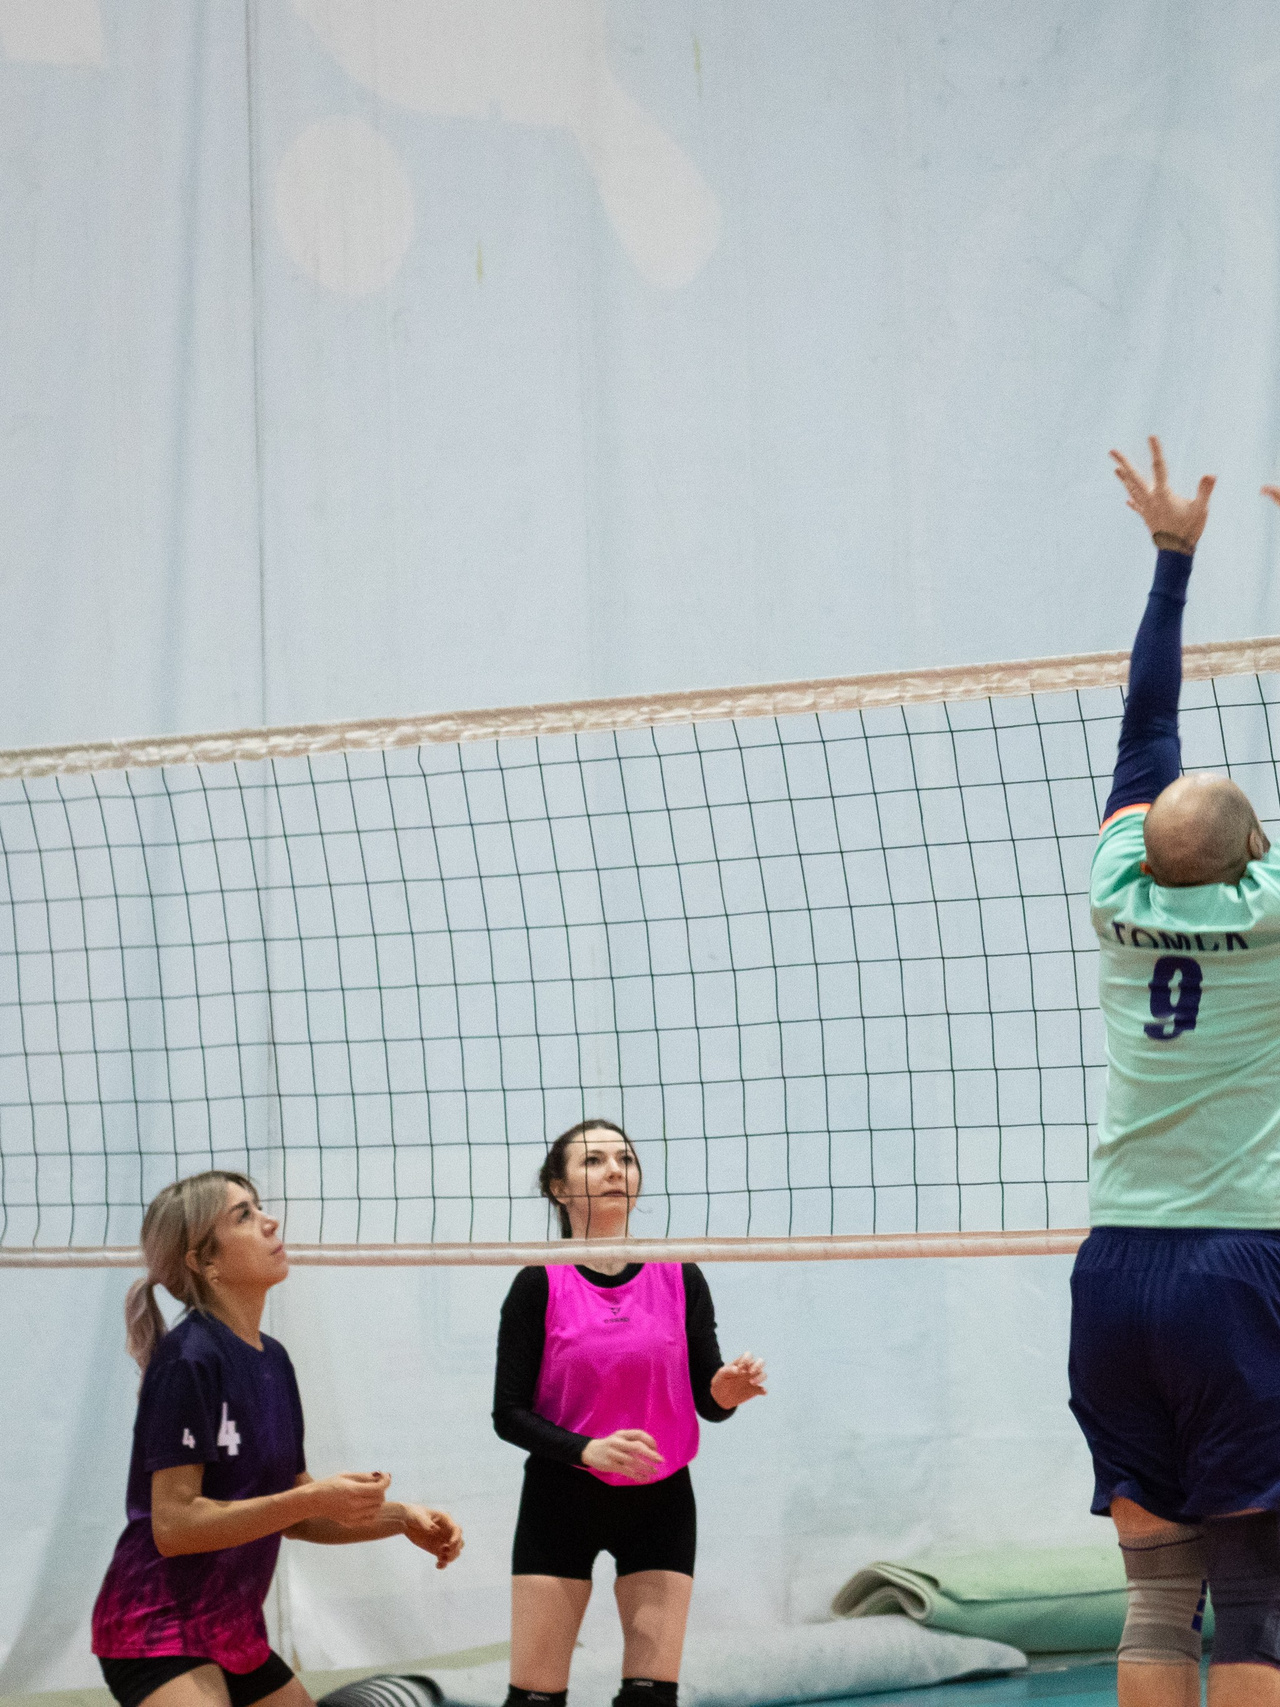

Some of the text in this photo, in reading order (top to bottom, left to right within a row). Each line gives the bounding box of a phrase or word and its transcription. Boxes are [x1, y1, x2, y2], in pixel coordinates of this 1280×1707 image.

[1144, 955, 1203, 1041] 9
[182, 1427, 196, 1449] 4
[217, 1401, 241, 1456] 4
